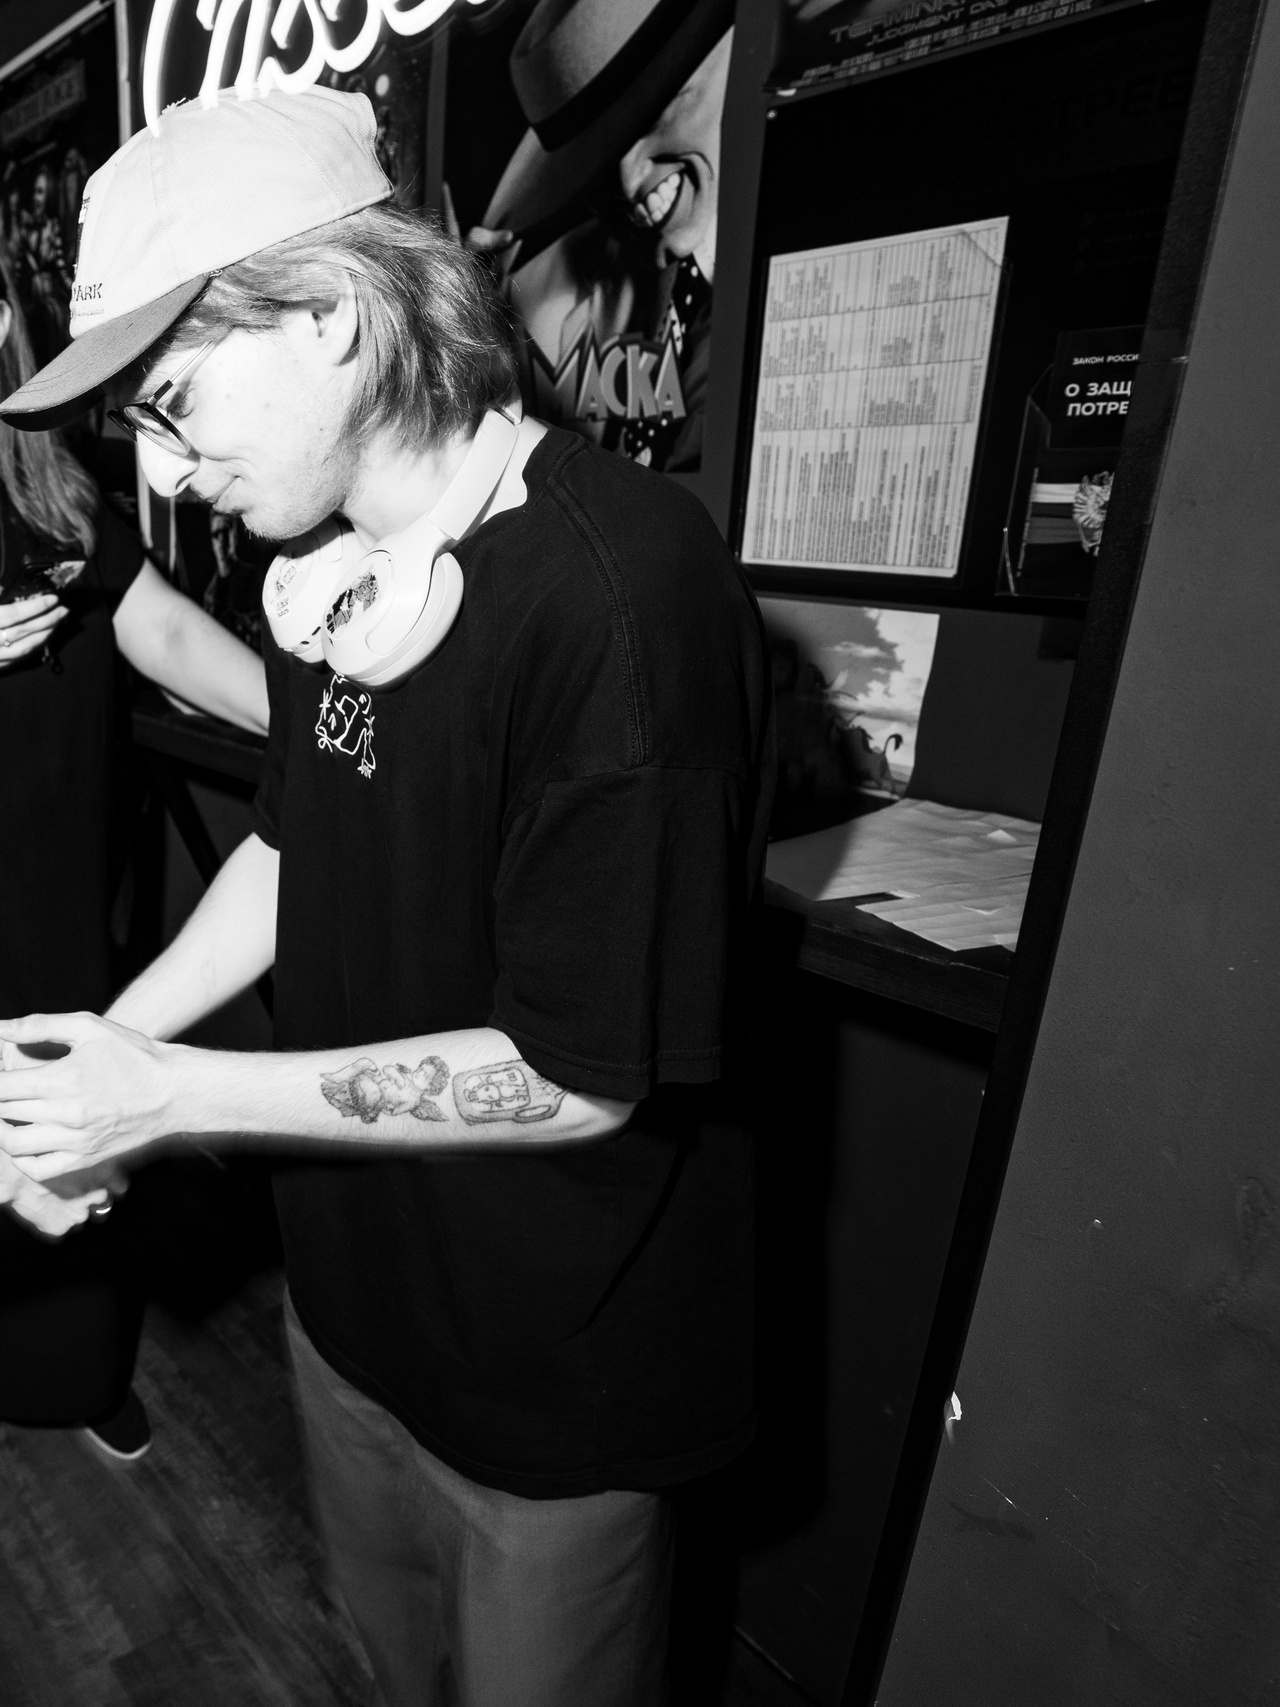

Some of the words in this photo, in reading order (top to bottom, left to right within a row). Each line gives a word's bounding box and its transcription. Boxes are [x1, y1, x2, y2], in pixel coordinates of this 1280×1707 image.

[1072, 356, 1105, 366] ЗАКОН
[528, 332, 687, 421] МАСКА
[1064, 383, 1080, 397] О
[1085, 380, 1132, 397] ЗАЩ
[1066, 401, 1130, 417] ПОТРЕ
